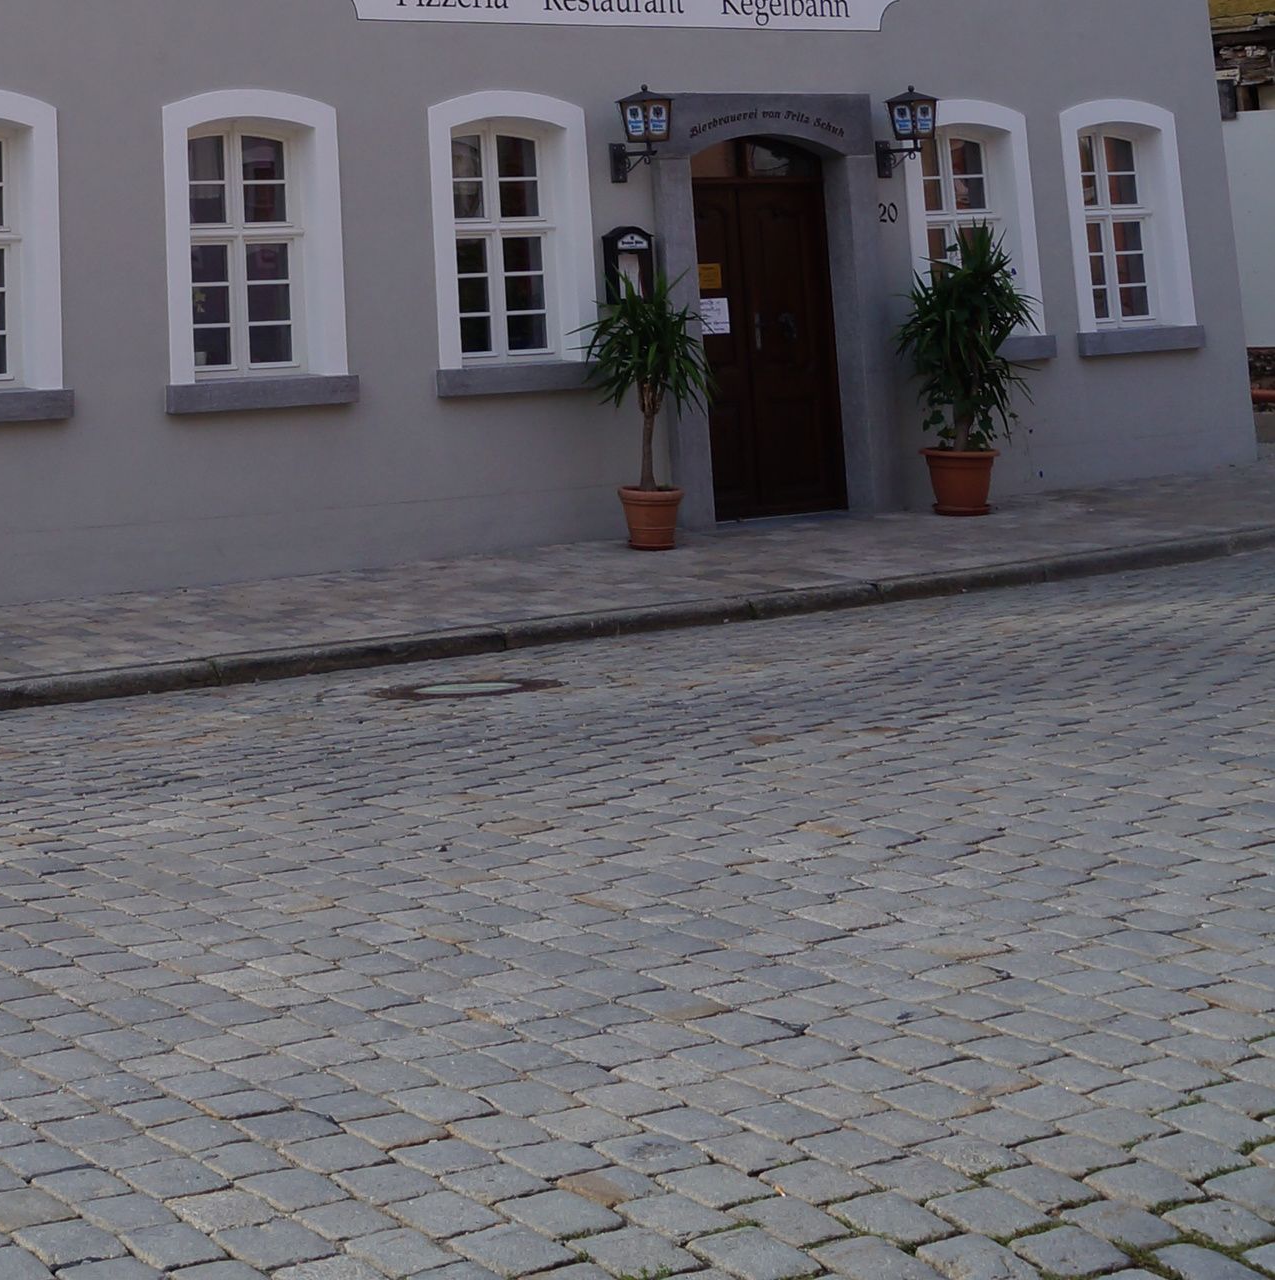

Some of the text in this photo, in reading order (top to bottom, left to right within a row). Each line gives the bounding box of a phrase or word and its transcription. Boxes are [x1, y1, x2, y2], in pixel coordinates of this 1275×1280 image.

[690, 108, 758, 138] Bierbrauerei
[762, 110, 781, 119] von
[878, 202, 898, 223] 20
